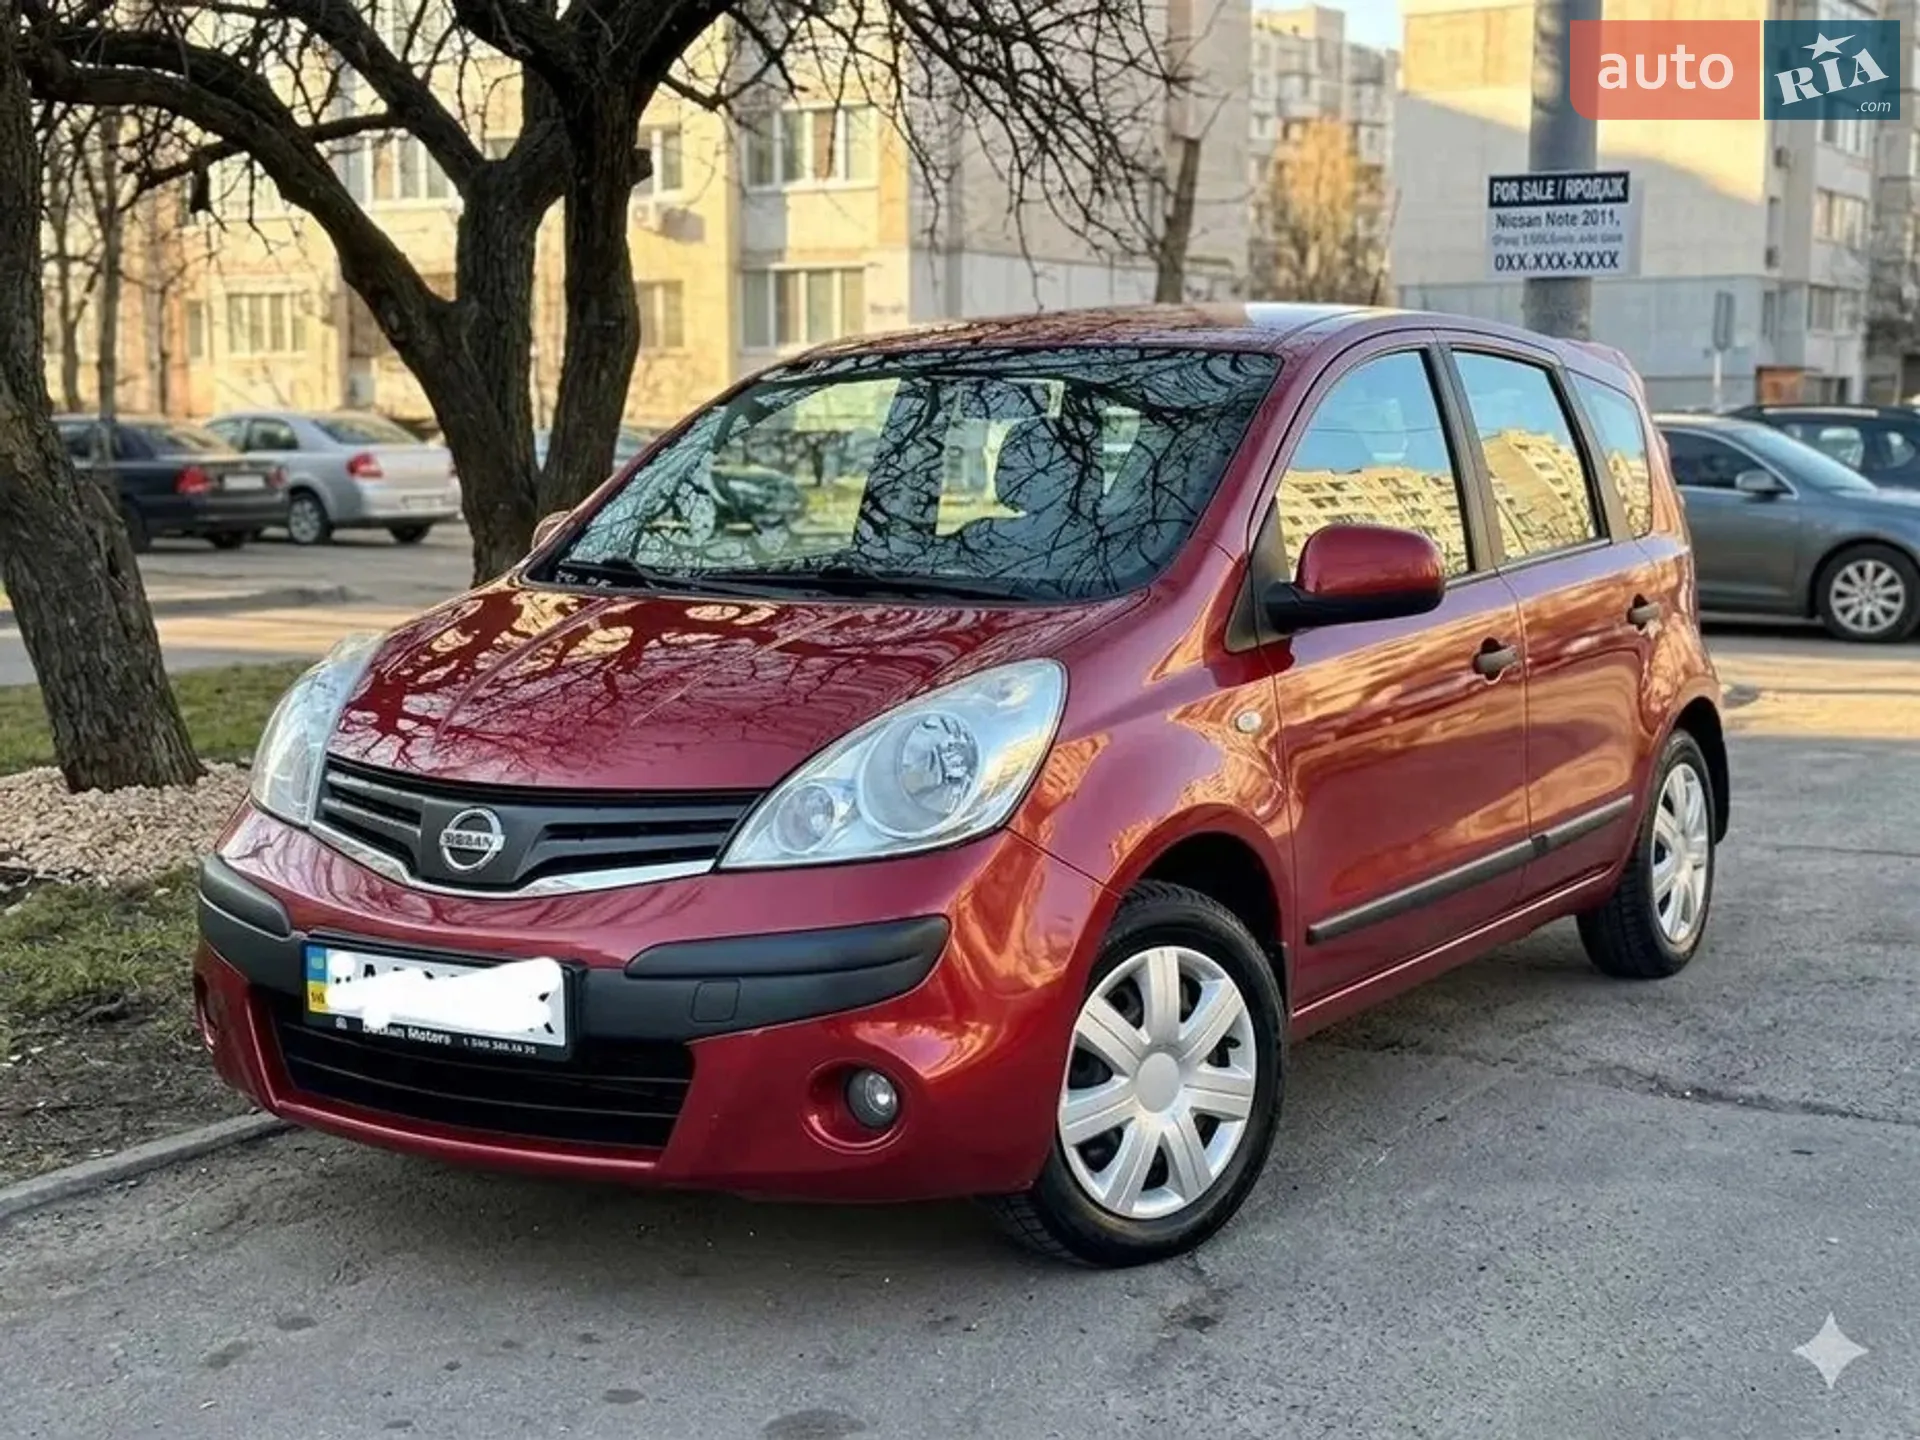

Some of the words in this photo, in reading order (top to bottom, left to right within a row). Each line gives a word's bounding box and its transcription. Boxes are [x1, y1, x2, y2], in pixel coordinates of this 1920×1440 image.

[1522, 179, 1555, 201] SALE
[1545, 210, 1578, 228] Note
[407, 1026, 452, 1045] Motors
